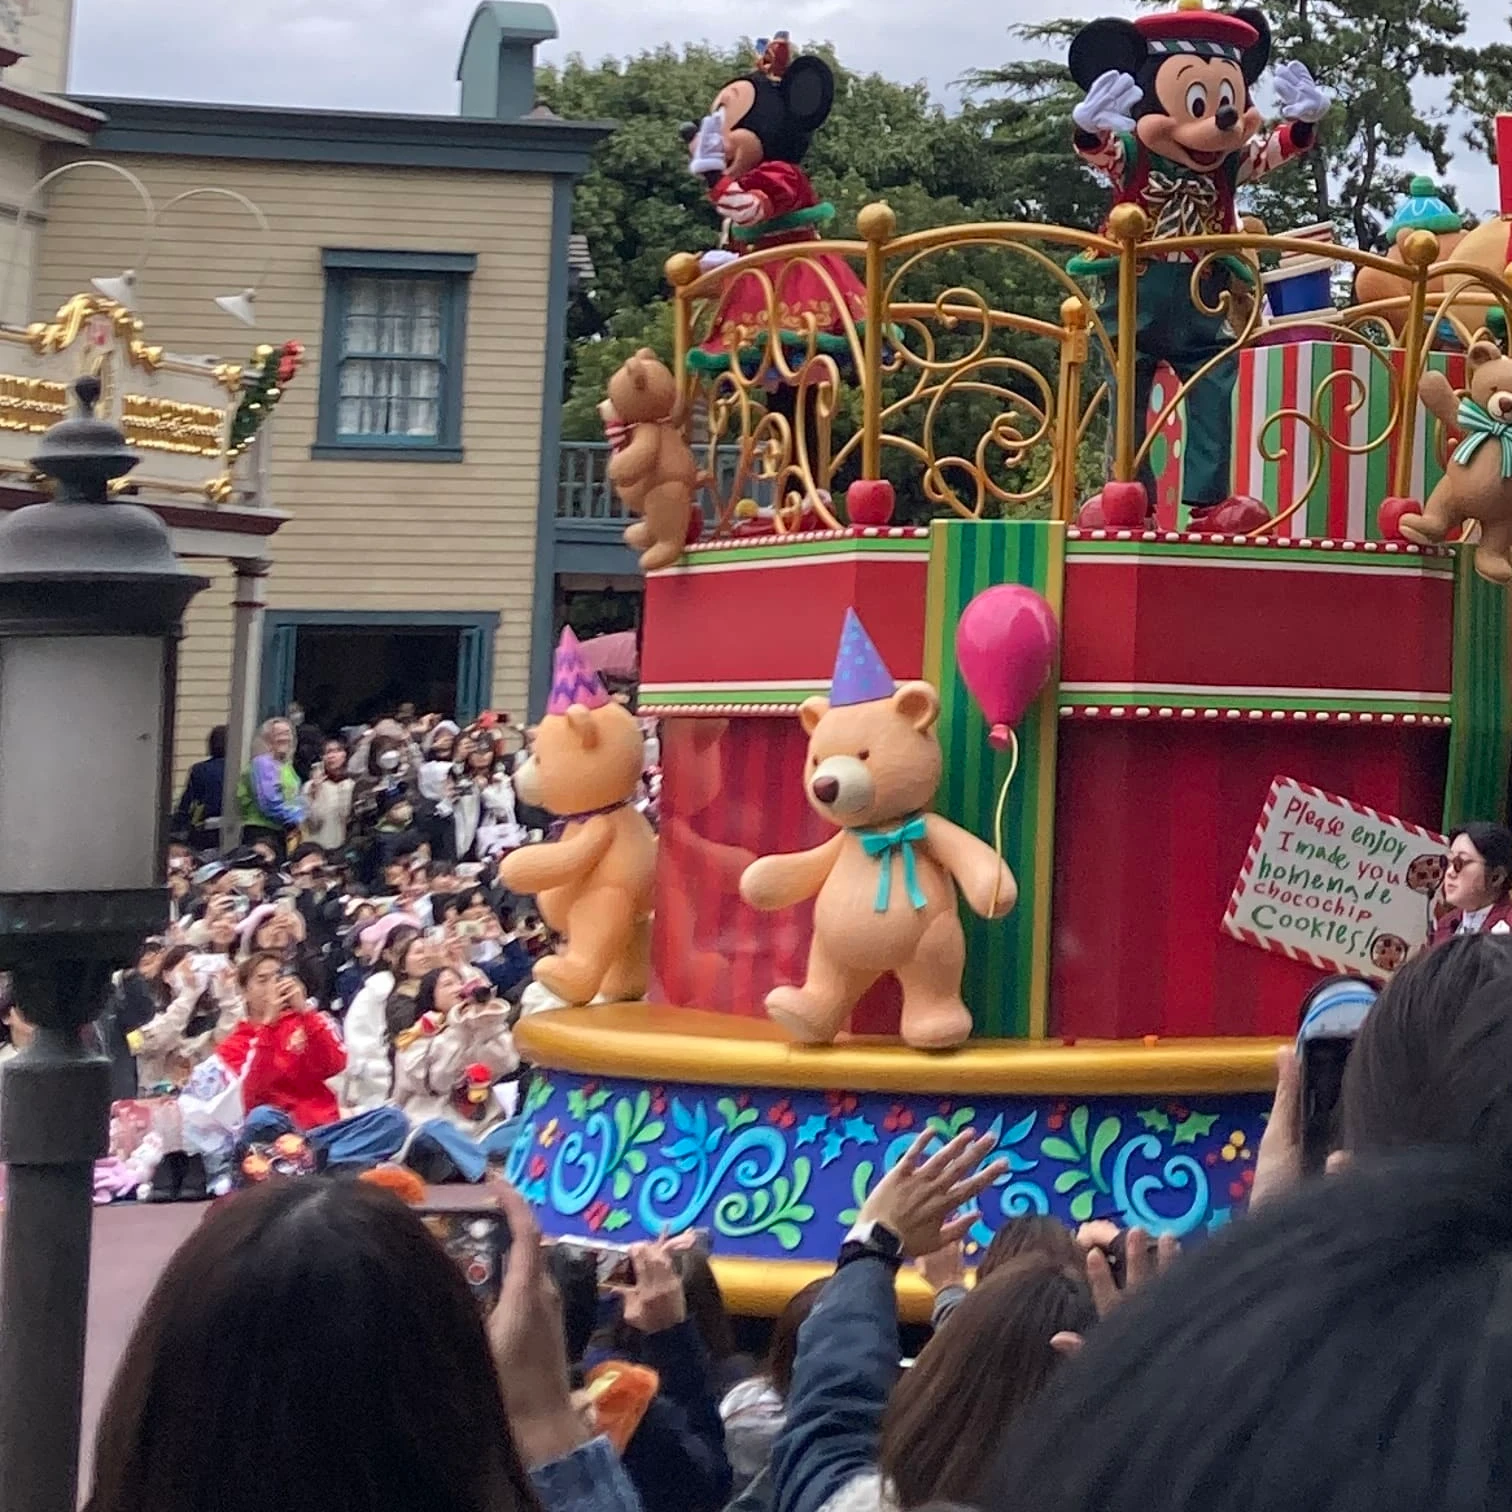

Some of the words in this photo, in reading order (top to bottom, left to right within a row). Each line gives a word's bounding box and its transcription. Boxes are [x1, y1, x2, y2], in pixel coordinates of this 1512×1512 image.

[1283, 795, 1345, 837] Please
[1351, 825, 1407, 865] enjoy
[1258, 852, 1392, 904] homemade
[1278, 831, 1294, 852] I
[1295, 839, 1350, 870] made
[1357, 860, 1400, 886] you
[1251, 904, 1378, 958] Cookies!
